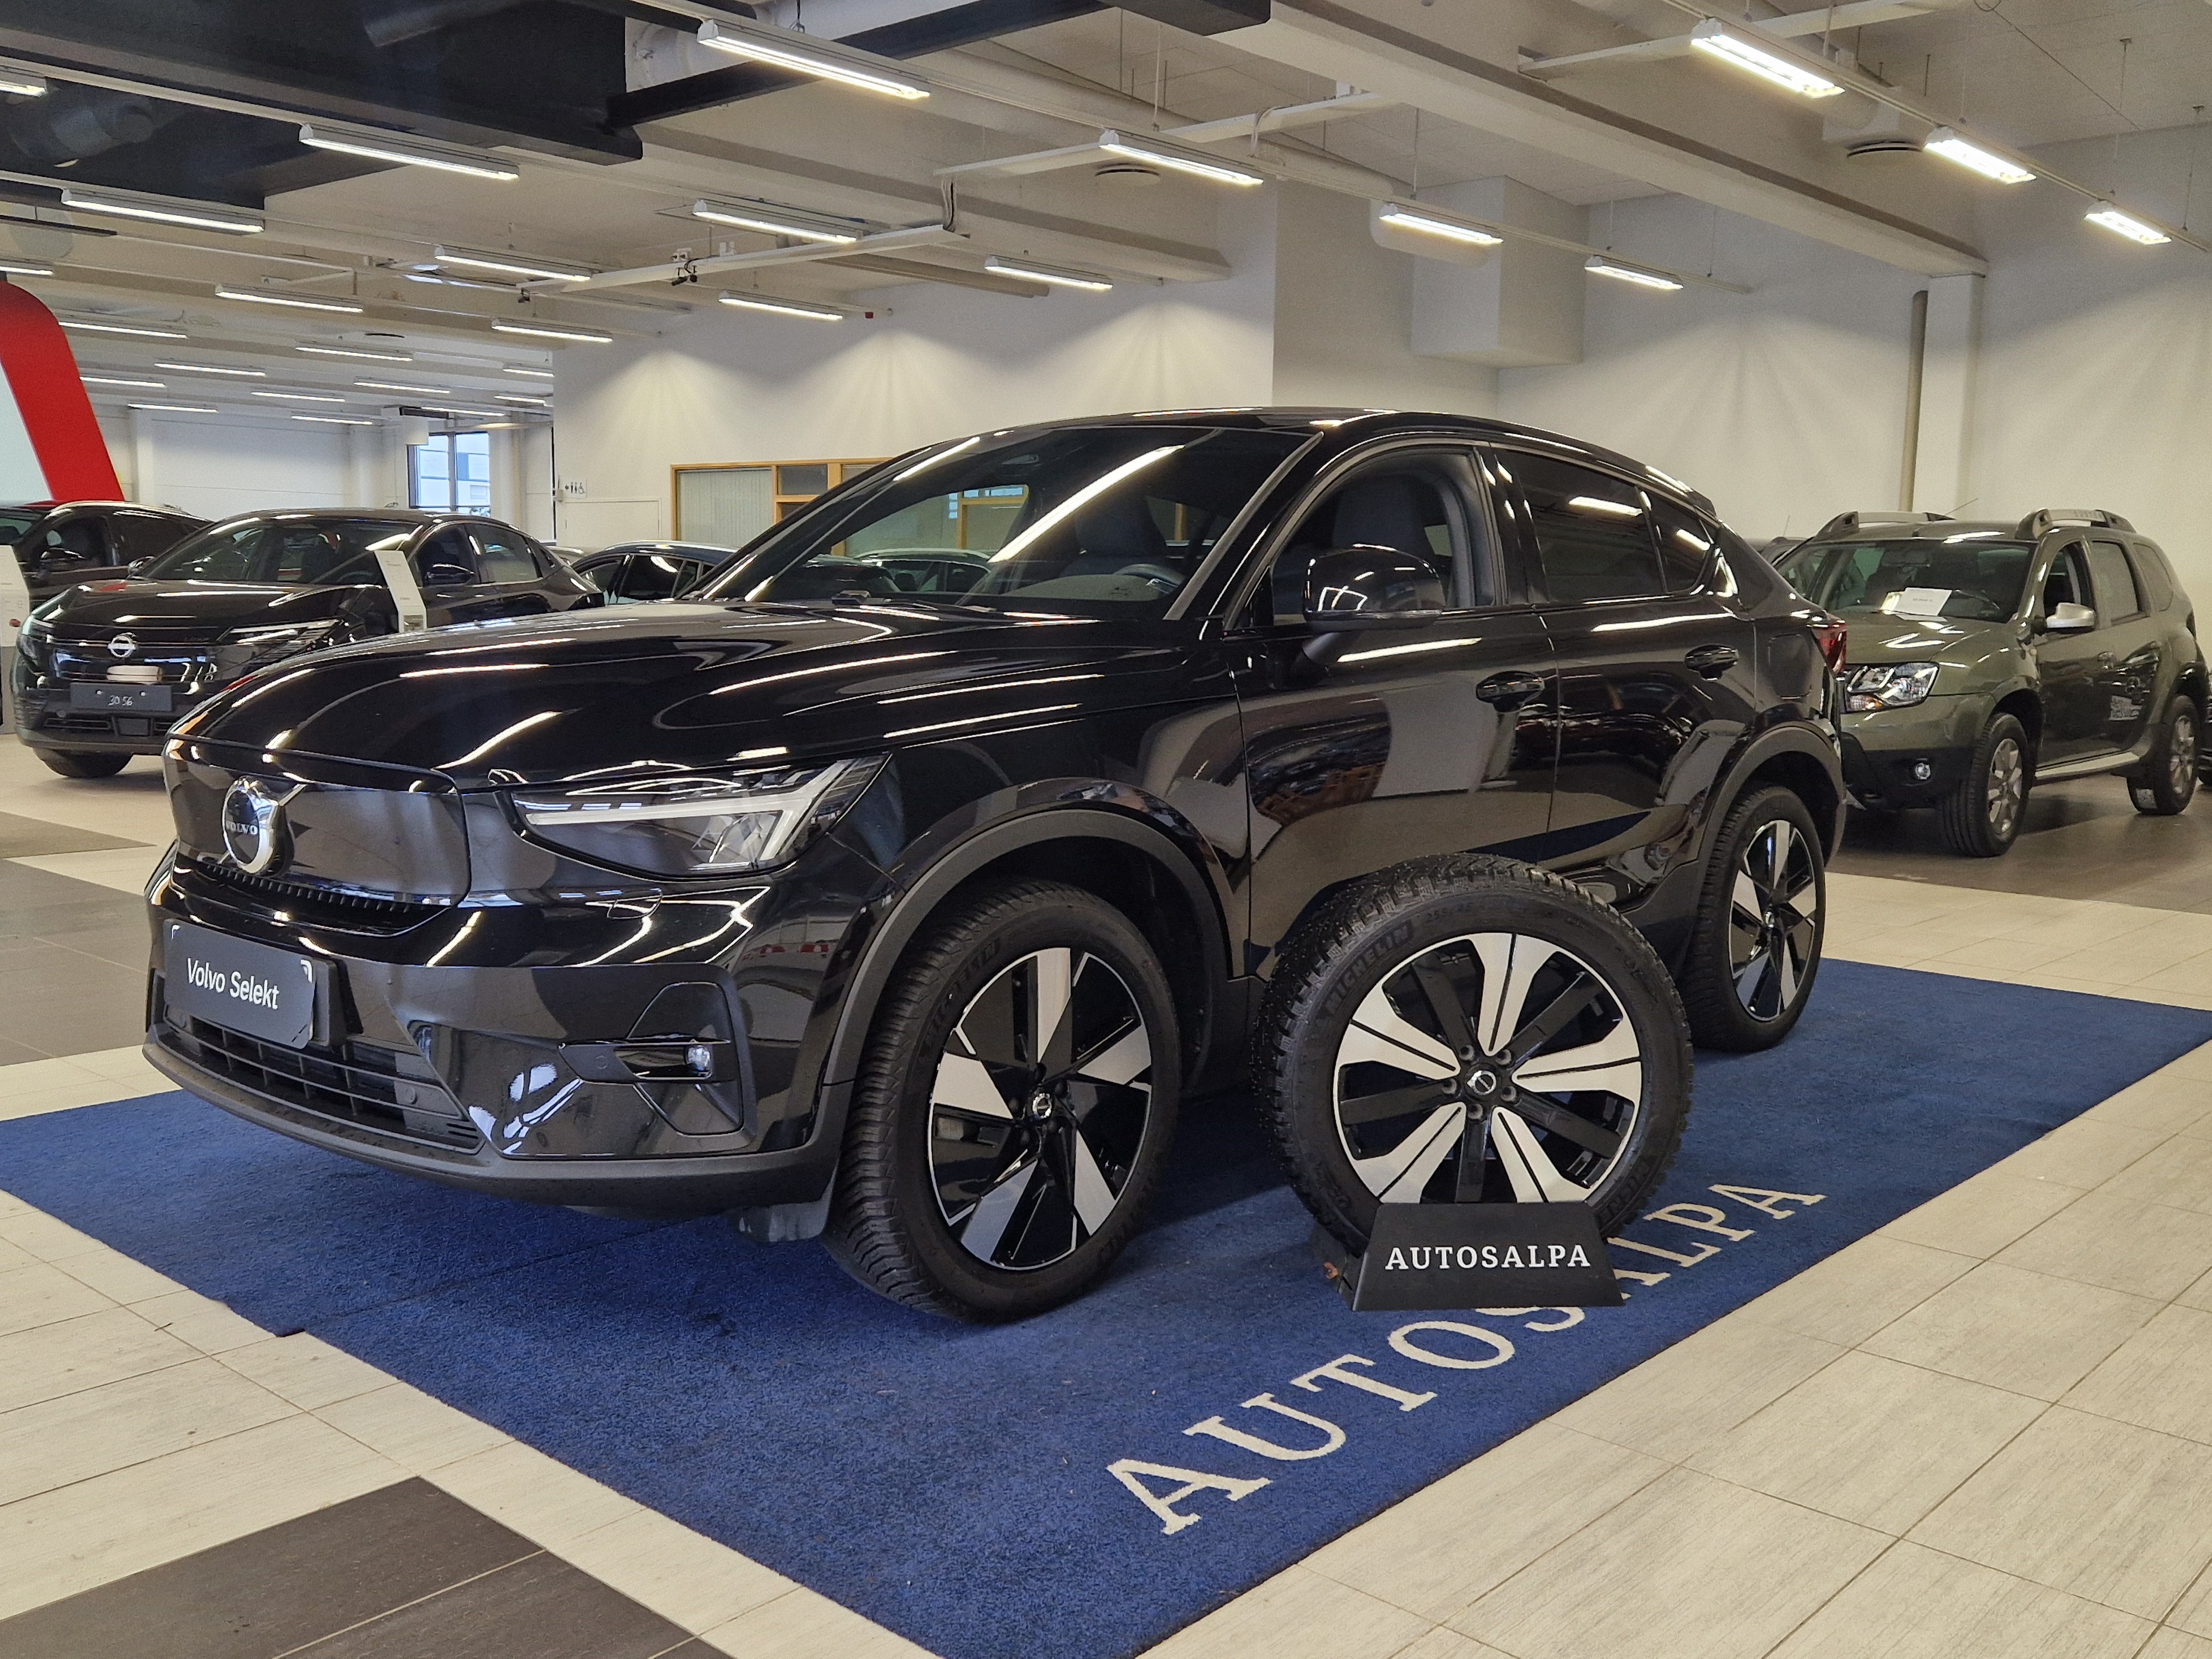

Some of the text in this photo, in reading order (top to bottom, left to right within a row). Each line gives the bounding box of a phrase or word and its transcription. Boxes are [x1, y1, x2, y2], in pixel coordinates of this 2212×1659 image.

[225, 820, 258, 836] VOLVO
[187, 957, 280, 1010] Volvo Selekt
[1326, 925, 1410, 1015] MICHELIN
[1385, 1244, 1591, 1270] AUTOSALPA
